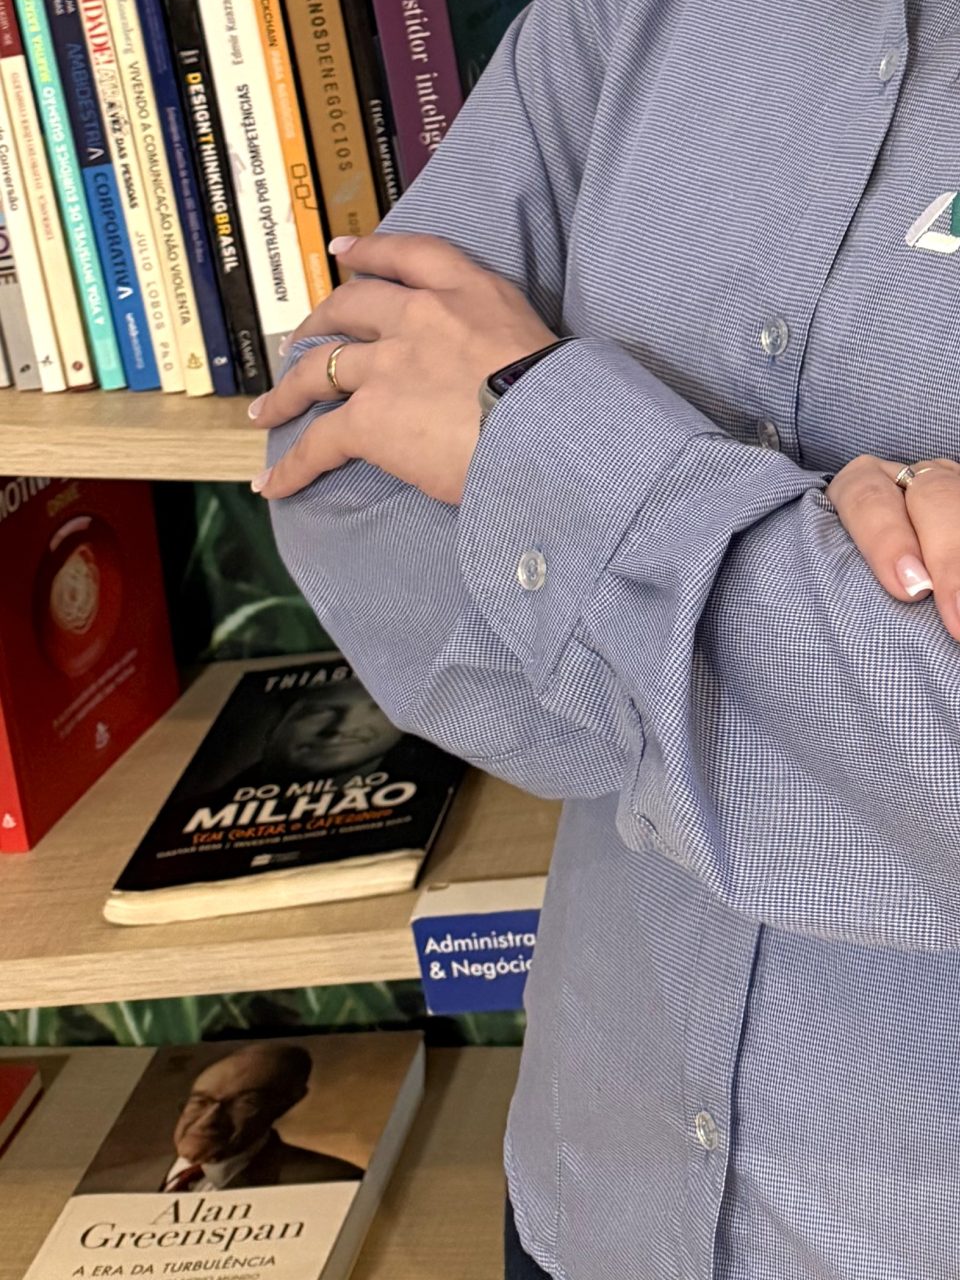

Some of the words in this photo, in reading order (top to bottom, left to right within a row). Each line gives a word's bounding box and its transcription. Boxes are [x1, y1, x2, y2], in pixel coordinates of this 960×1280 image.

[228, 35, 244, 65] Edmir
[128, 61, 150, 119] VIVENDO
[141, 122, 153, 133] A
[236, 83, 266, 176] COMPETÊNCIAS
[115, 138, 128, 159] DAS
[143, 136, 173, 233] COMUNICAÇÃO
[377, 136, 399, 203] EMPRESARI
[121, 163, 139, 209] PESSOAS
[255, 178, 270, 204] POR
[69, 205, 81, 222] DE
[94, 172, 133, 300] CORPORATIVA
[164, 233, 179, 262] NÃO
[257, 205, 289, 303] ADMINISTRAÇÃO
[135, 230, 153, 272] JULIO
[147, 280, 166, 329] LOBOS
[87, 284, 103, 315] VIDA
[170, 266, 191, 326] VIOLENTA
[238, 330, 258, 378] CAMPUS
[264, 666, 358, 693] THIAG
[233, 784, 281, 802] DO
[285, 779, 338, 797] MIL
[342, 772, 389, 788] AO
[182, 781, 417, 835] MILHÃO
[192, 830, 224, 845] SEM
[227, 823, 286, 841] CORTAR
[430, 961, 446, 979] &
[152, 1198, 252, 1225] Alan
[80, 1221, 305, 1252] Greenspan
[72, 1266, 84, 1277] A
[91, 1265, 123, 1277] ERA
[130, 1264, 154, 1275] DA
[163, 1255, 276, 1274] TURBULÊNCIA
